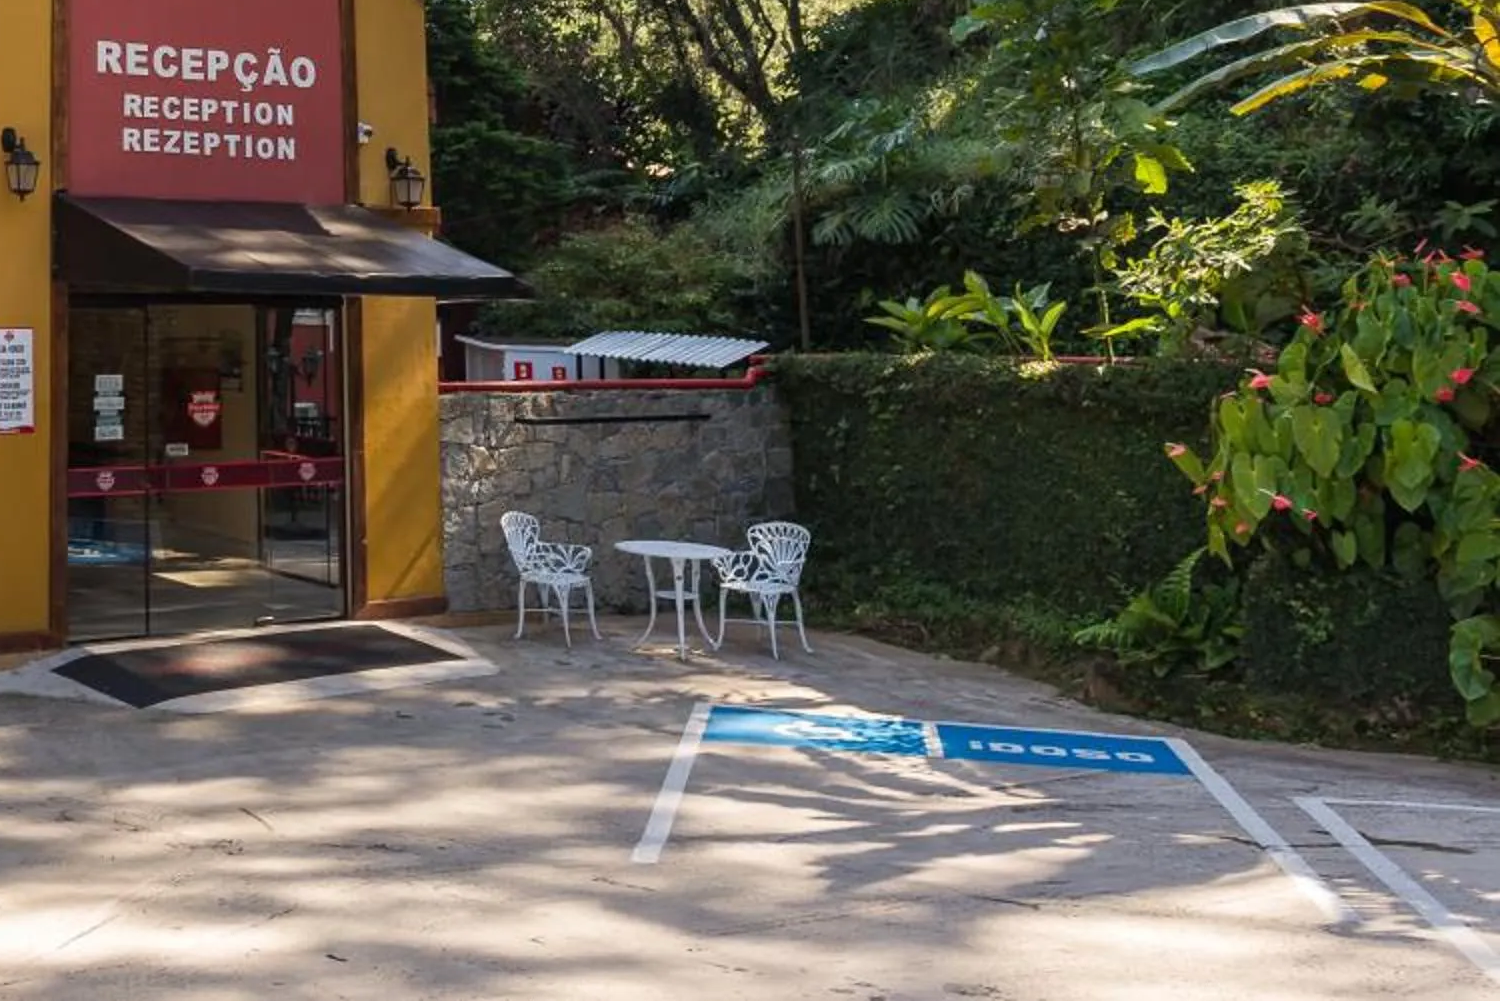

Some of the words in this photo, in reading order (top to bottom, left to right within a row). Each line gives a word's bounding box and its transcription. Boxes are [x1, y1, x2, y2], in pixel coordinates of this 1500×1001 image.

[97, 40, 317, 92] RECEPÇÃO
[123, 93, 294, 126] RECEPTION
[122, 127, 296, 160] REZEPTION
[969, 740, 1155, 764] IDOSO
